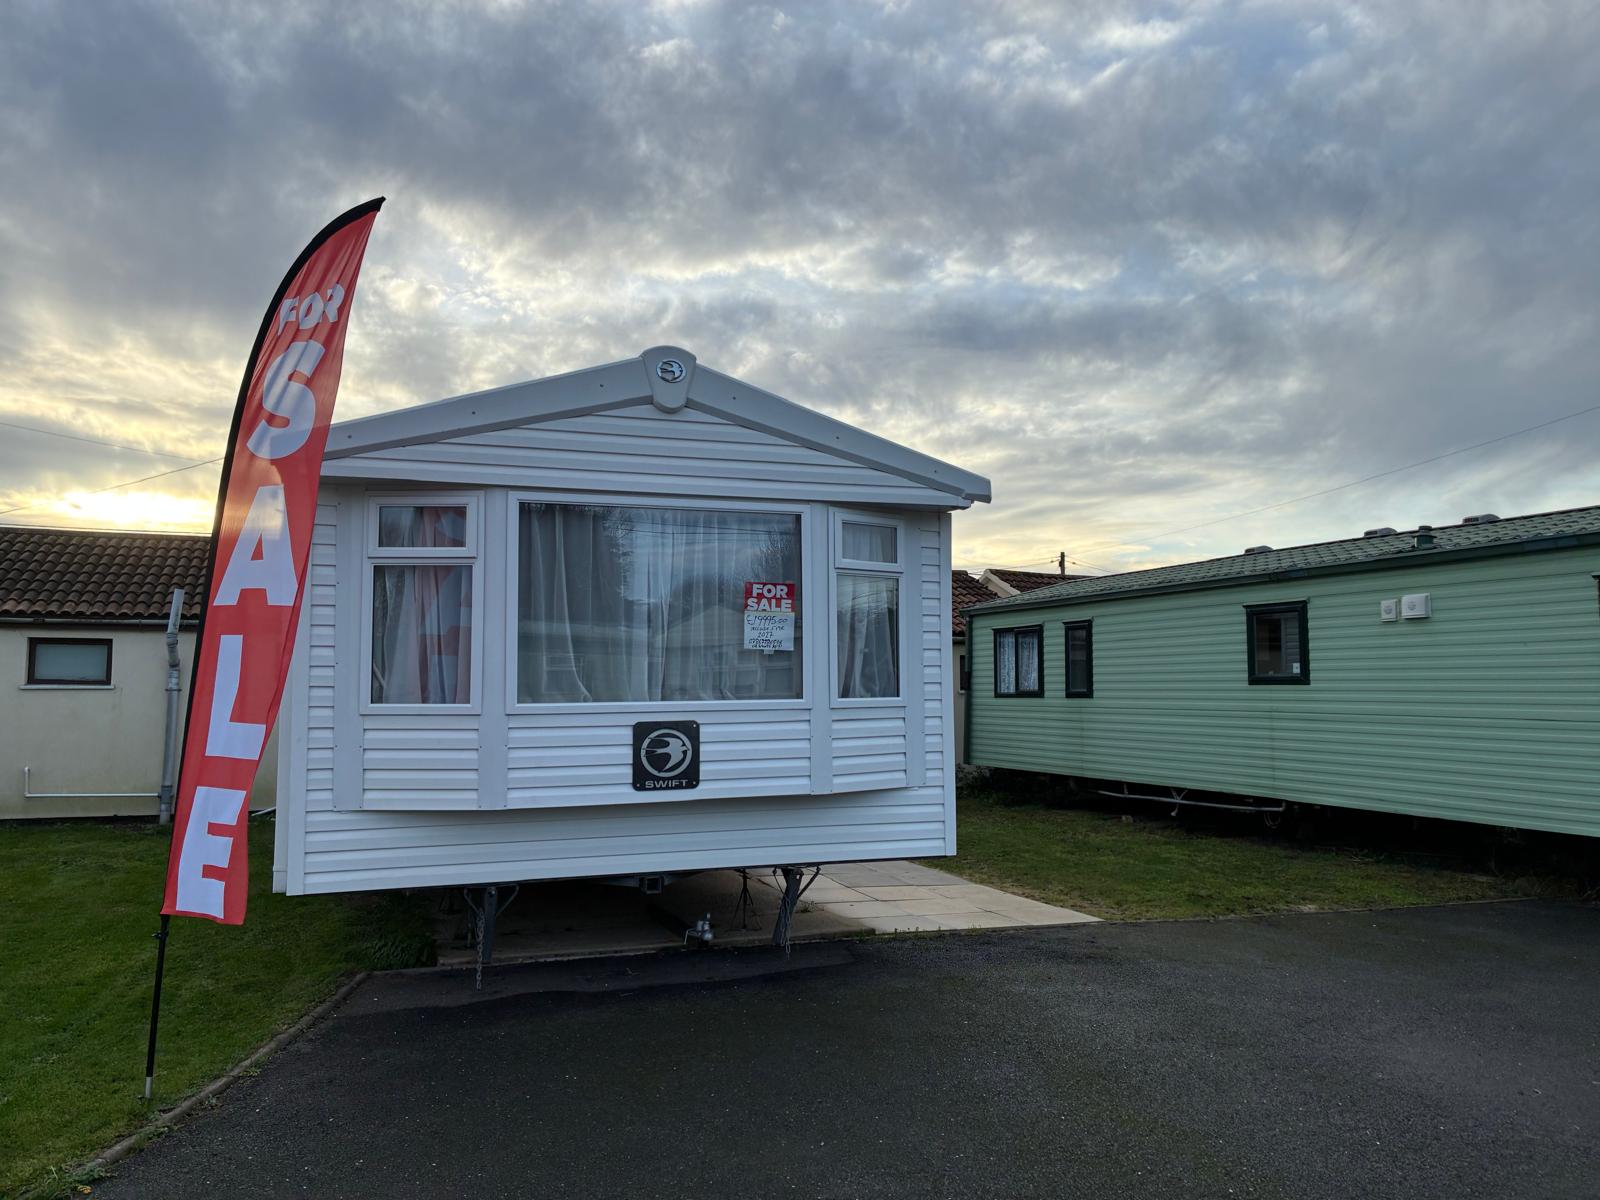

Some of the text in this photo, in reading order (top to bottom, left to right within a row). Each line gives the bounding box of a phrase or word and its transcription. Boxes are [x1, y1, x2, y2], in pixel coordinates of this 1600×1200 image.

[277, 282, 345, 336] FOR
[752, 583, 788, 598] FOR
[746, 597, 792, 612] SALE
[176, 339, 325, 919] SALE
[645, 779, 689, 788] SWIFT
